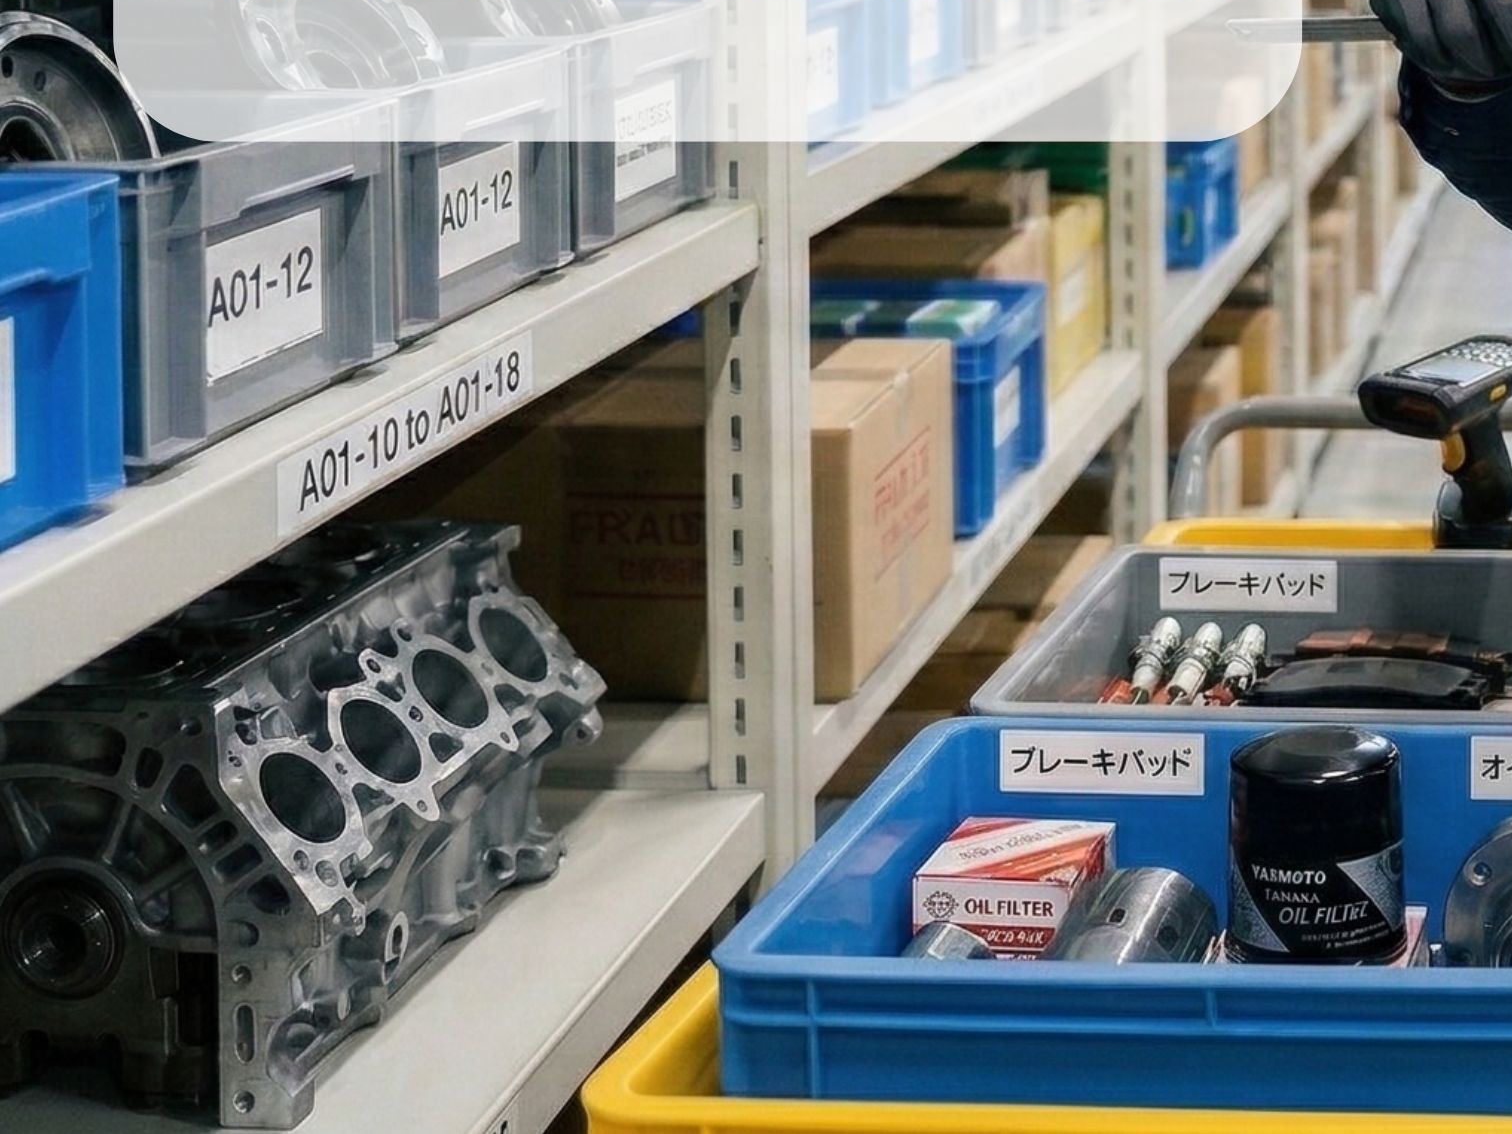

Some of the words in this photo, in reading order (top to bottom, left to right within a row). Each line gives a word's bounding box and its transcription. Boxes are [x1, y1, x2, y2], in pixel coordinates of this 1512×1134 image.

[440, 169, 514, 236] A01-12
[208, 245, 313, 327] A01-12
[299, 417, 399, 512] A01-10
[406, 407, 430, 450] to
[436, 350, 521, 434] A01-18
[964, 897, 995, 915] OIL
[996, 900, 1054, 917] FILTER
[1278, 906, 1310, 925] OIL
